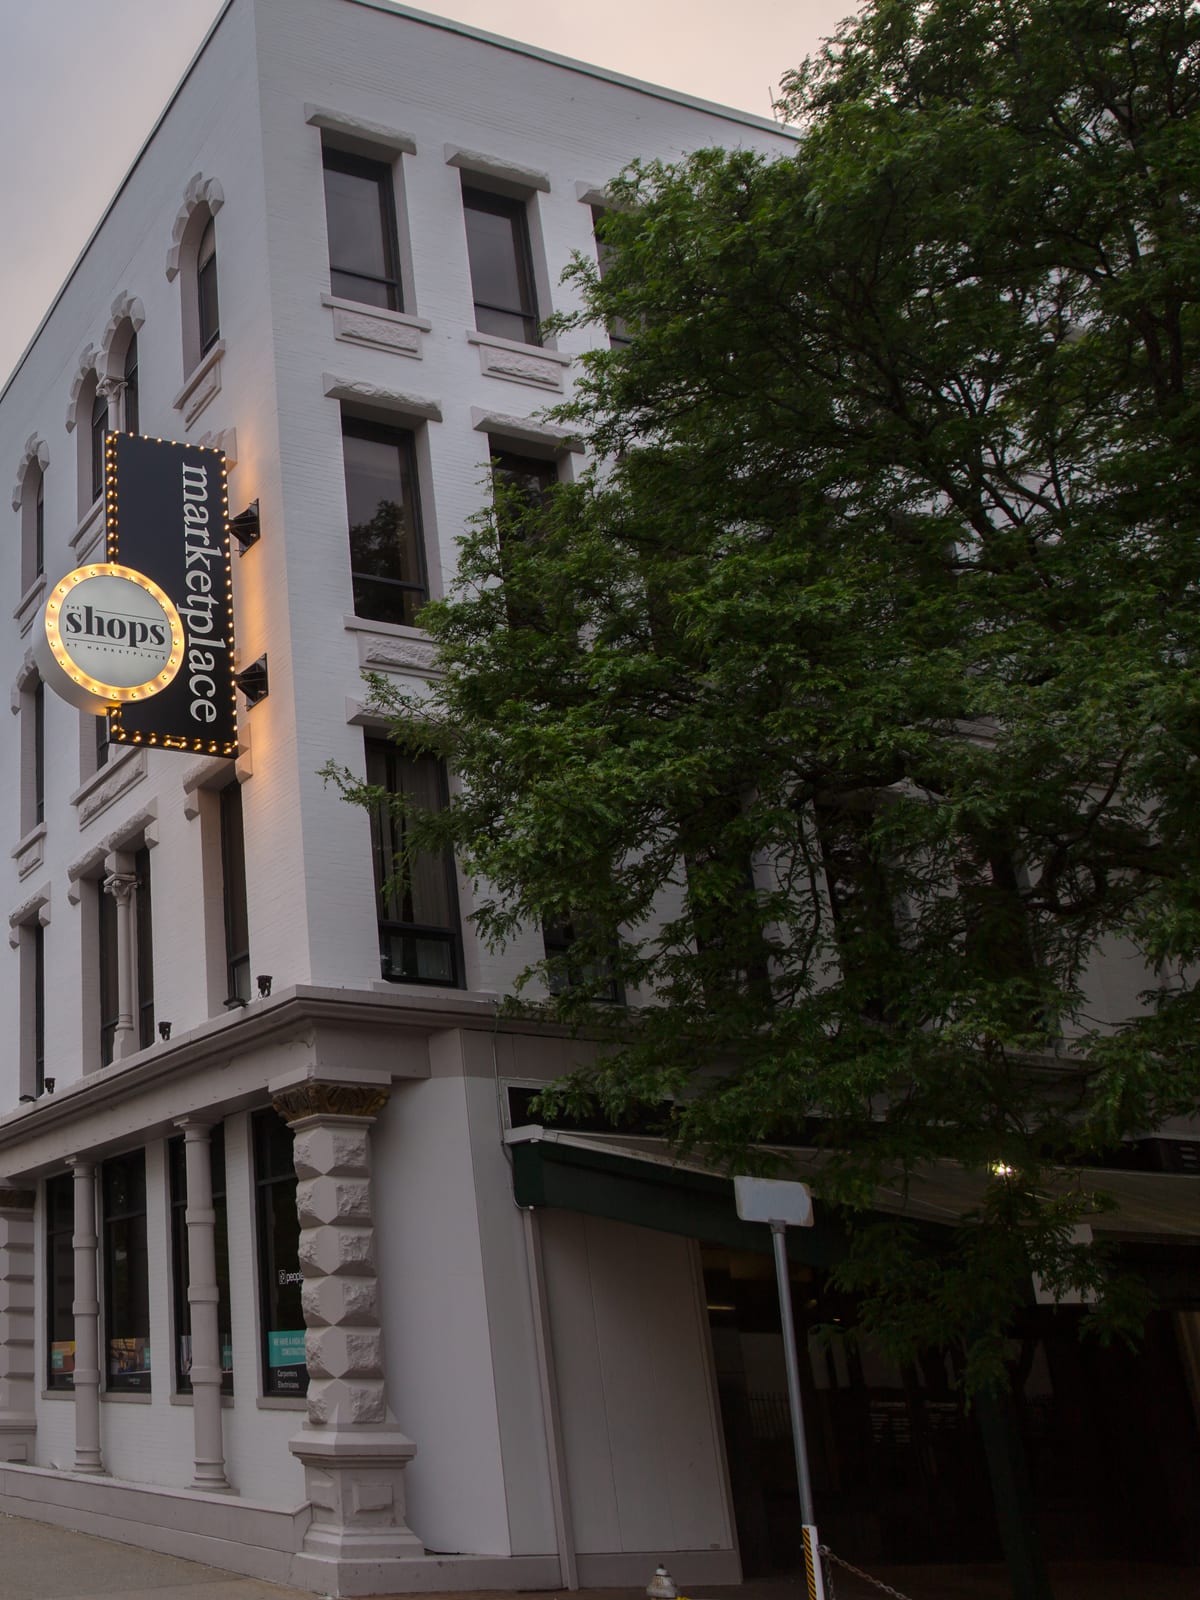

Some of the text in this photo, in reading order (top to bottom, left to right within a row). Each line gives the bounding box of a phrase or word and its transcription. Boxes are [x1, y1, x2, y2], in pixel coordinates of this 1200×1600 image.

[177, 462, 226, 723] marketplace
[66, 605, 166, 649] shops
[87, 645, 166, 661] MARKETPLACE
